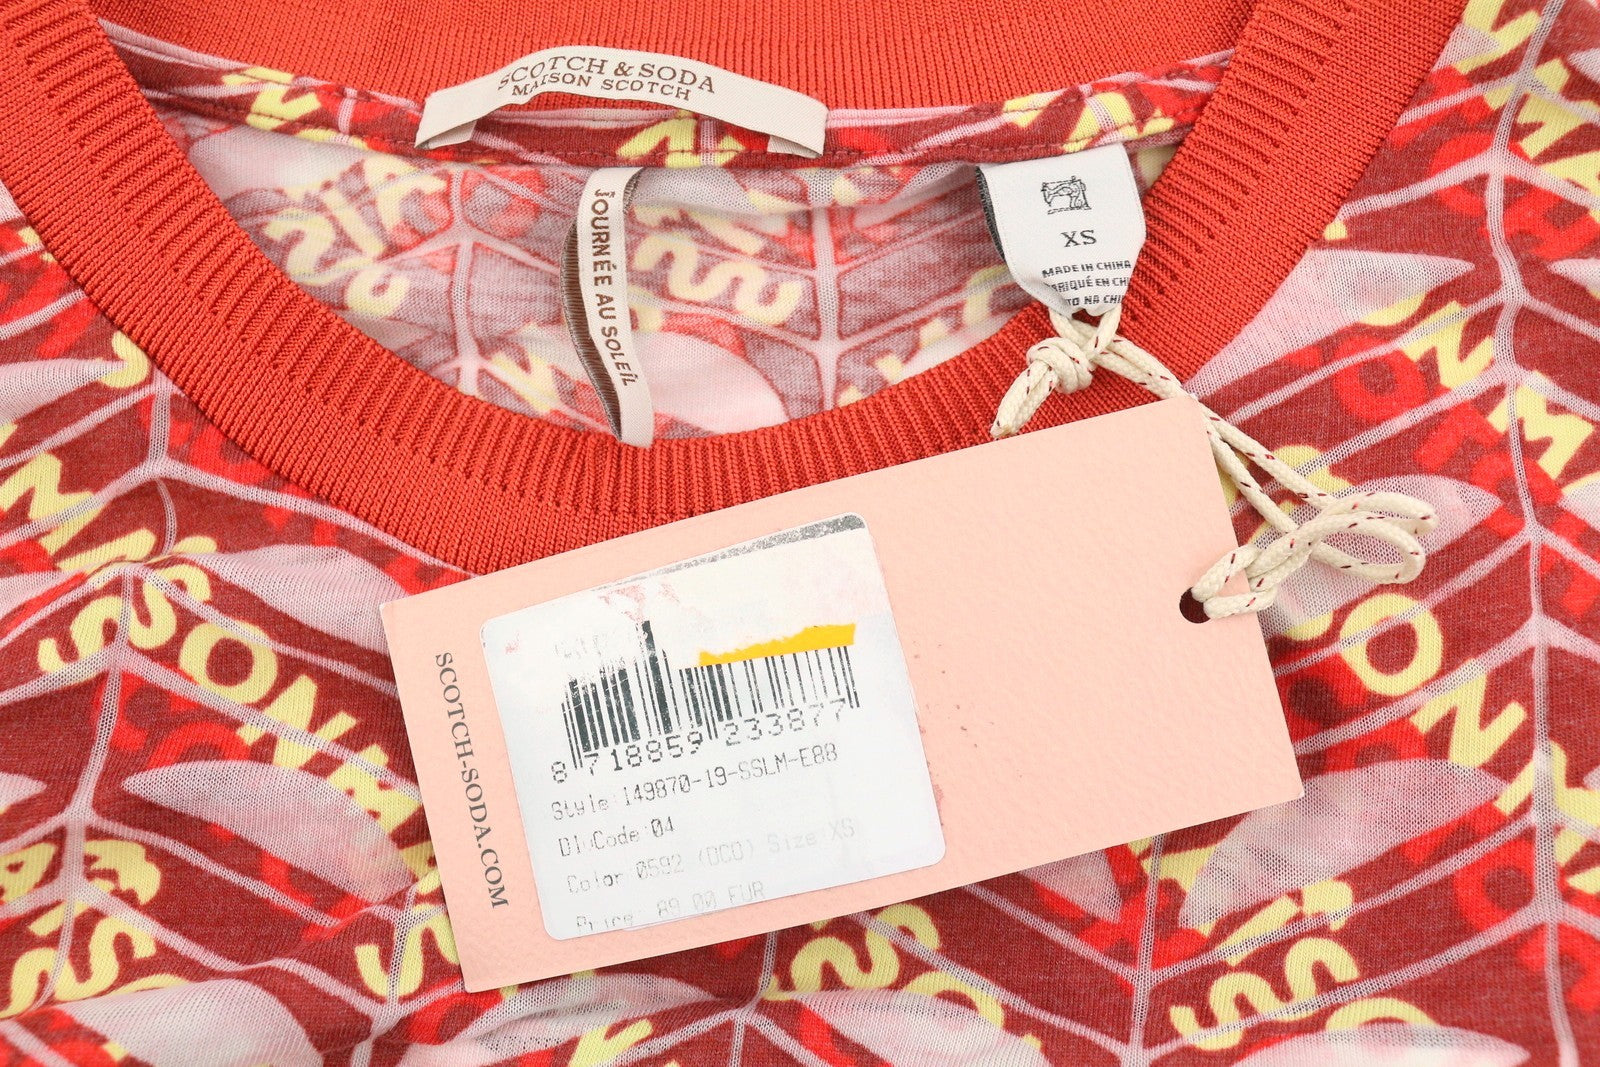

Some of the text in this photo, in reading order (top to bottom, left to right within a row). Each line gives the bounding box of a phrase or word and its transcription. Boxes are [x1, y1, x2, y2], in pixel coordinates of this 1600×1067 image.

[498, 56, 715, 94] SCOTCH & SODA
[511, 72, 692, 101] MAISON SCOTCH
[1061, 229, 1097, 248] XS
[1041, 260, 1132, 278] MADE IN CHINA
[1095, 278, 1110, 287] EN
[595, 293, 617, 320] AU
[1084, 295, 1100, 304] NA
[551, 699, 847, 784] 8 718859 233877
[435, 651, 509, 909] SCOTCH-SODA.COM
